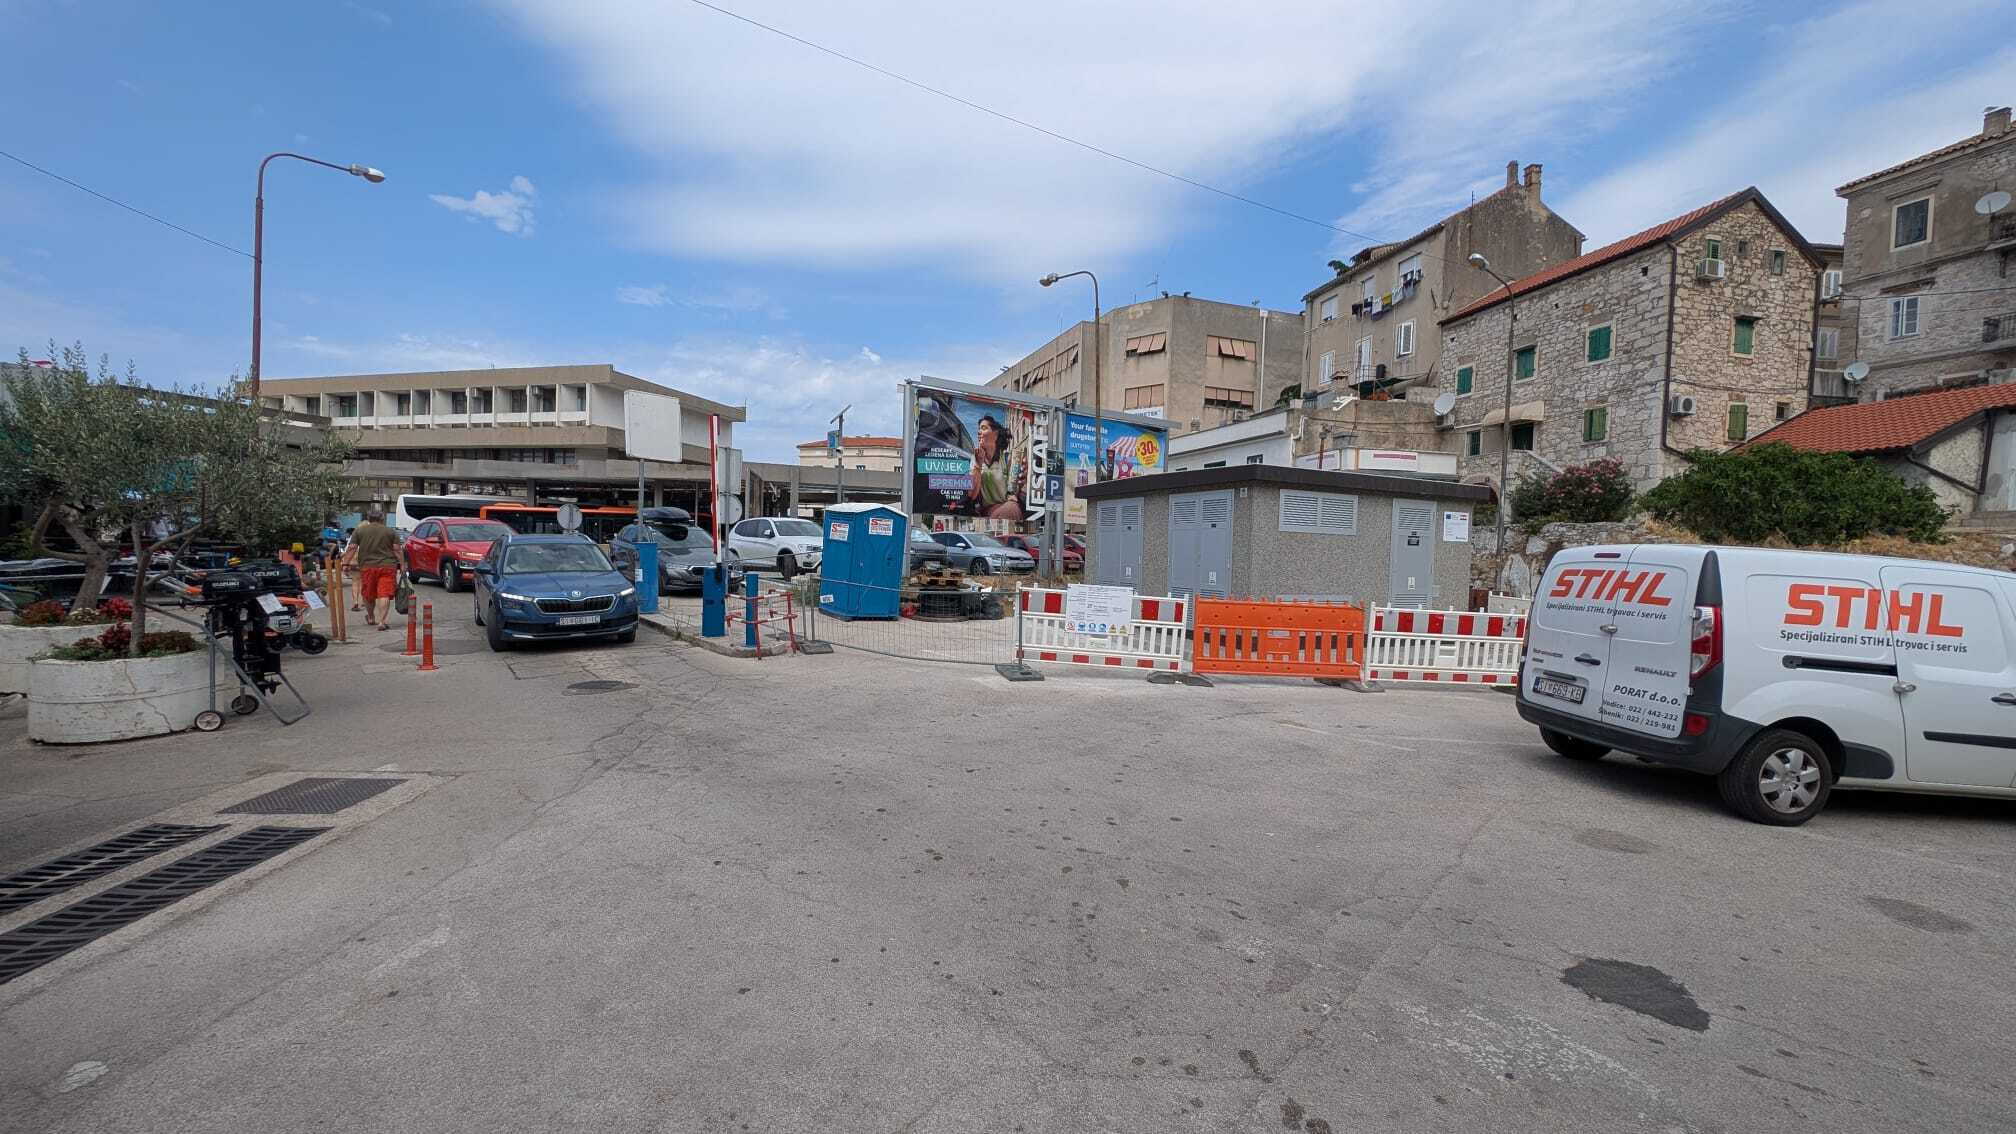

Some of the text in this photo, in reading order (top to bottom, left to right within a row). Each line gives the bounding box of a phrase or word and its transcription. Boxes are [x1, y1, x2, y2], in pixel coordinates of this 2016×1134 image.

[1070, 422, 1084, 430] Your
[925, 462, 962, 472] UVIJEK
[931, 478, 972, 488] SPREMNA
[1050, 480, 1059, 496] P
[1549, 569, 1672, 606] STIHL
[1586, 605, 1606, 614] STIHL
[1641, 612, 1667, 620] servis
[1784, 584, 1964, 638] STIHL
[1780, 630, 1857, 646] Specijalizirani
[1860, 636, 1892, 647] STIHL
[1936, 643, 1967, 653] servis
[1613, 684, 1681, 706] PORAT d.o.o.
